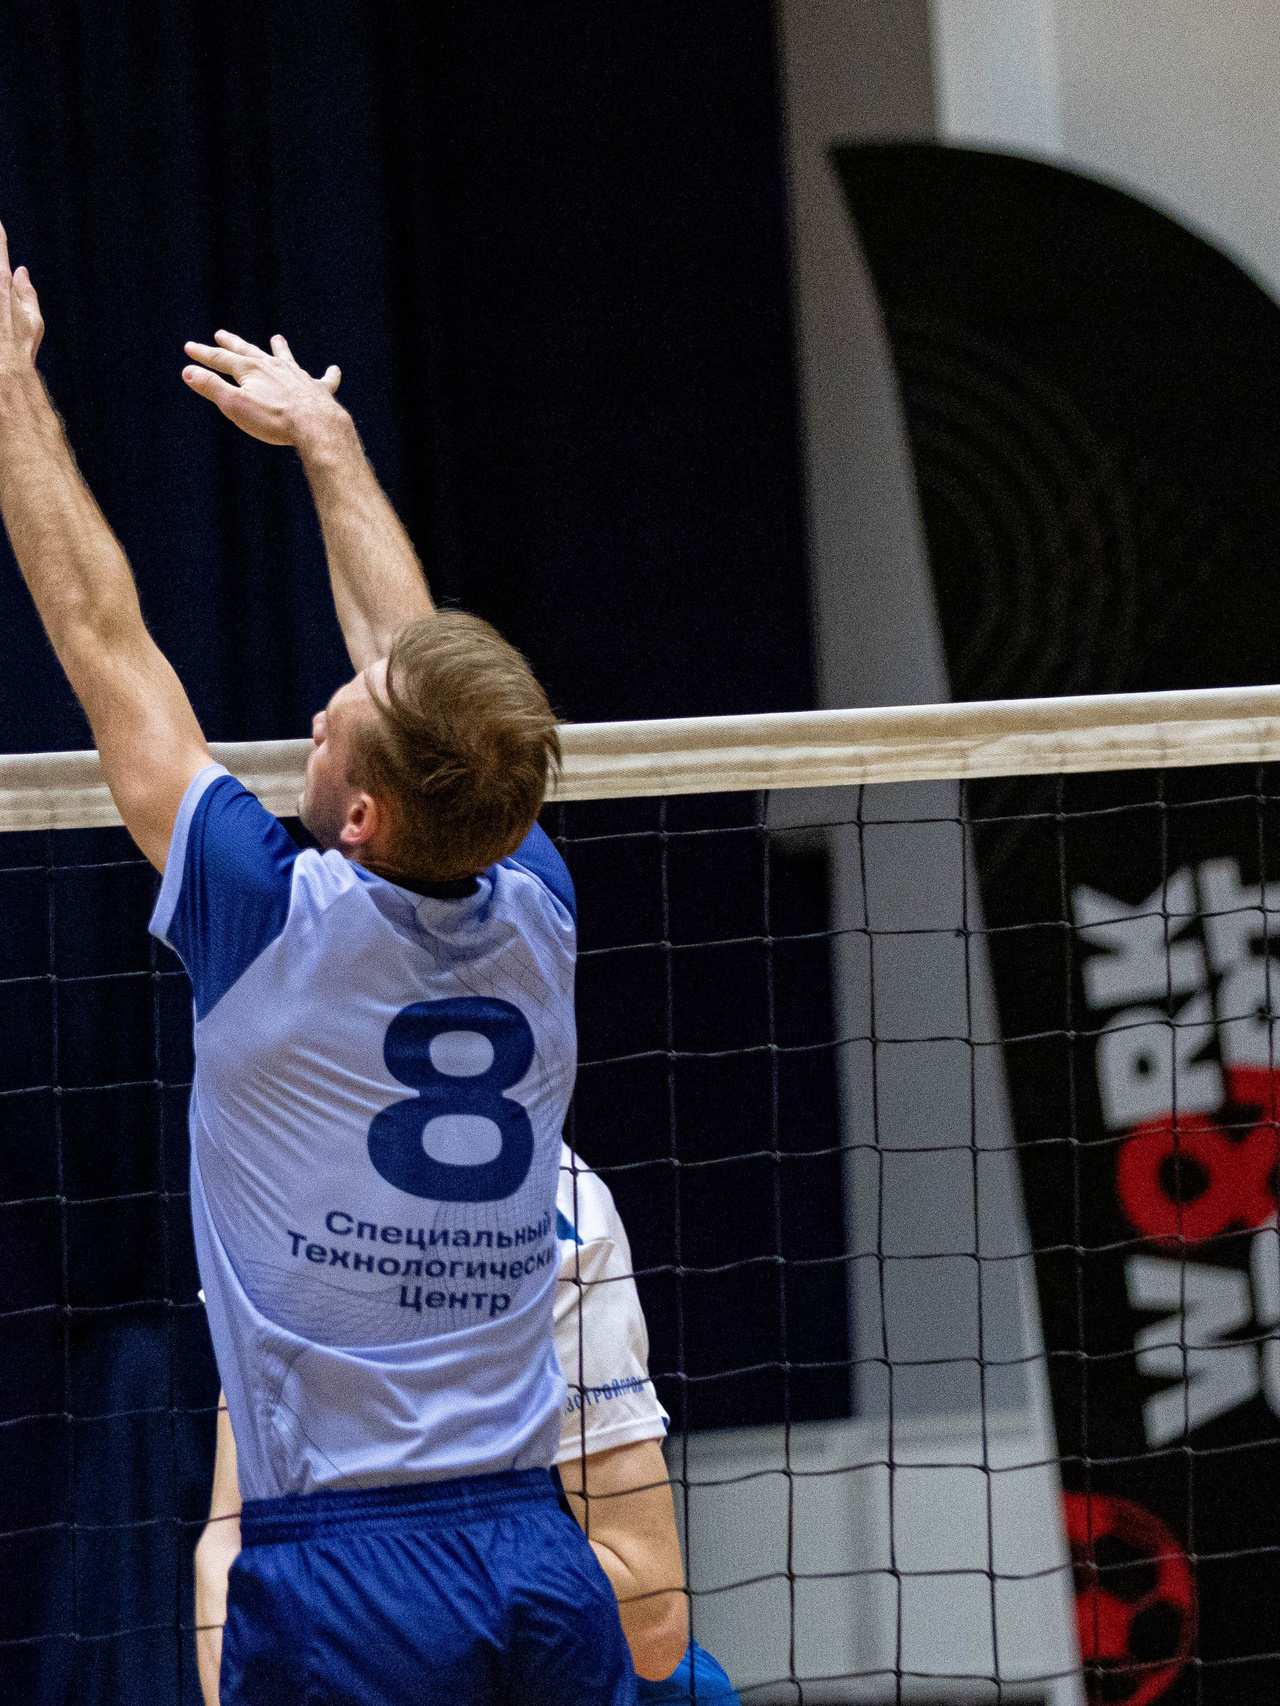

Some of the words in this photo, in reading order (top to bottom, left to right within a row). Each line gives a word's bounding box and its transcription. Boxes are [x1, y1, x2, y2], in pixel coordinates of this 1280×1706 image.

[368, 996, 535, 1202] 8
[325, 1210, 551, 1249] Специальный
[286, 1229, 555, 1280] Технологически
[399, 1285, 512, 1317] Центр
